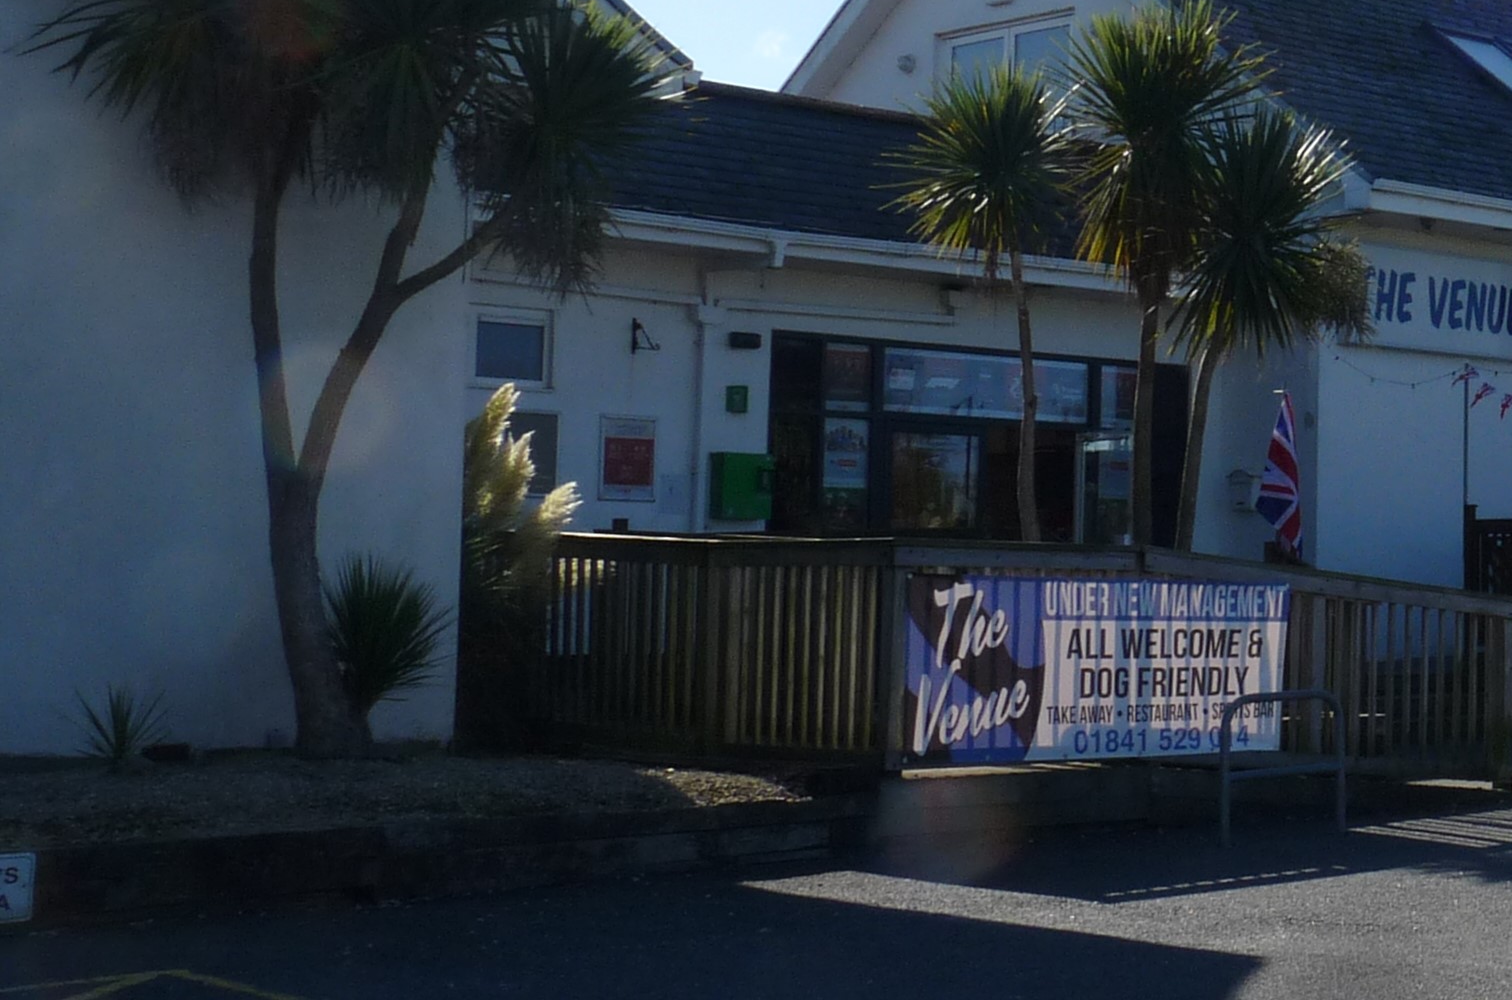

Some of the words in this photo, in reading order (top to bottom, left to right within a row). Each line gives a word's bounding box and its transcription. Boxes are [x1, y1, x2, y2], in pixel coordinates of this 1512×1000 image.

[1365, 266, 1416, 324] HE
[1045, 580, 1110, 617] UNDER
[1114, 580, 1158, 617] NEW
[1160, 582, 1289, 618] MANAGEMENT
[933, 582, 1009, 669] The
[1067, 628, 1113, 659] ALL
[1121, 628, 1242, 659] WELCOME
[1248, 629, 1263, 658] &
[1080, 667, 1129, 698] DOG
[1138, 666, 1249, 697] FRIENDLY
[912, 657, 1030, 757] Venue
[1046, 706, 1077, 724] TAKE
[1080, 704, 1114, 724] AWAY
[1127, 703, 1199, 722] RESTAURANT
[1253, 700, 1275, 718] BAR
[1073, 729, 1148, 754] 01841
[1159, 727, 1201, 751] 529
[1209, 725, 1249, 749] 04
